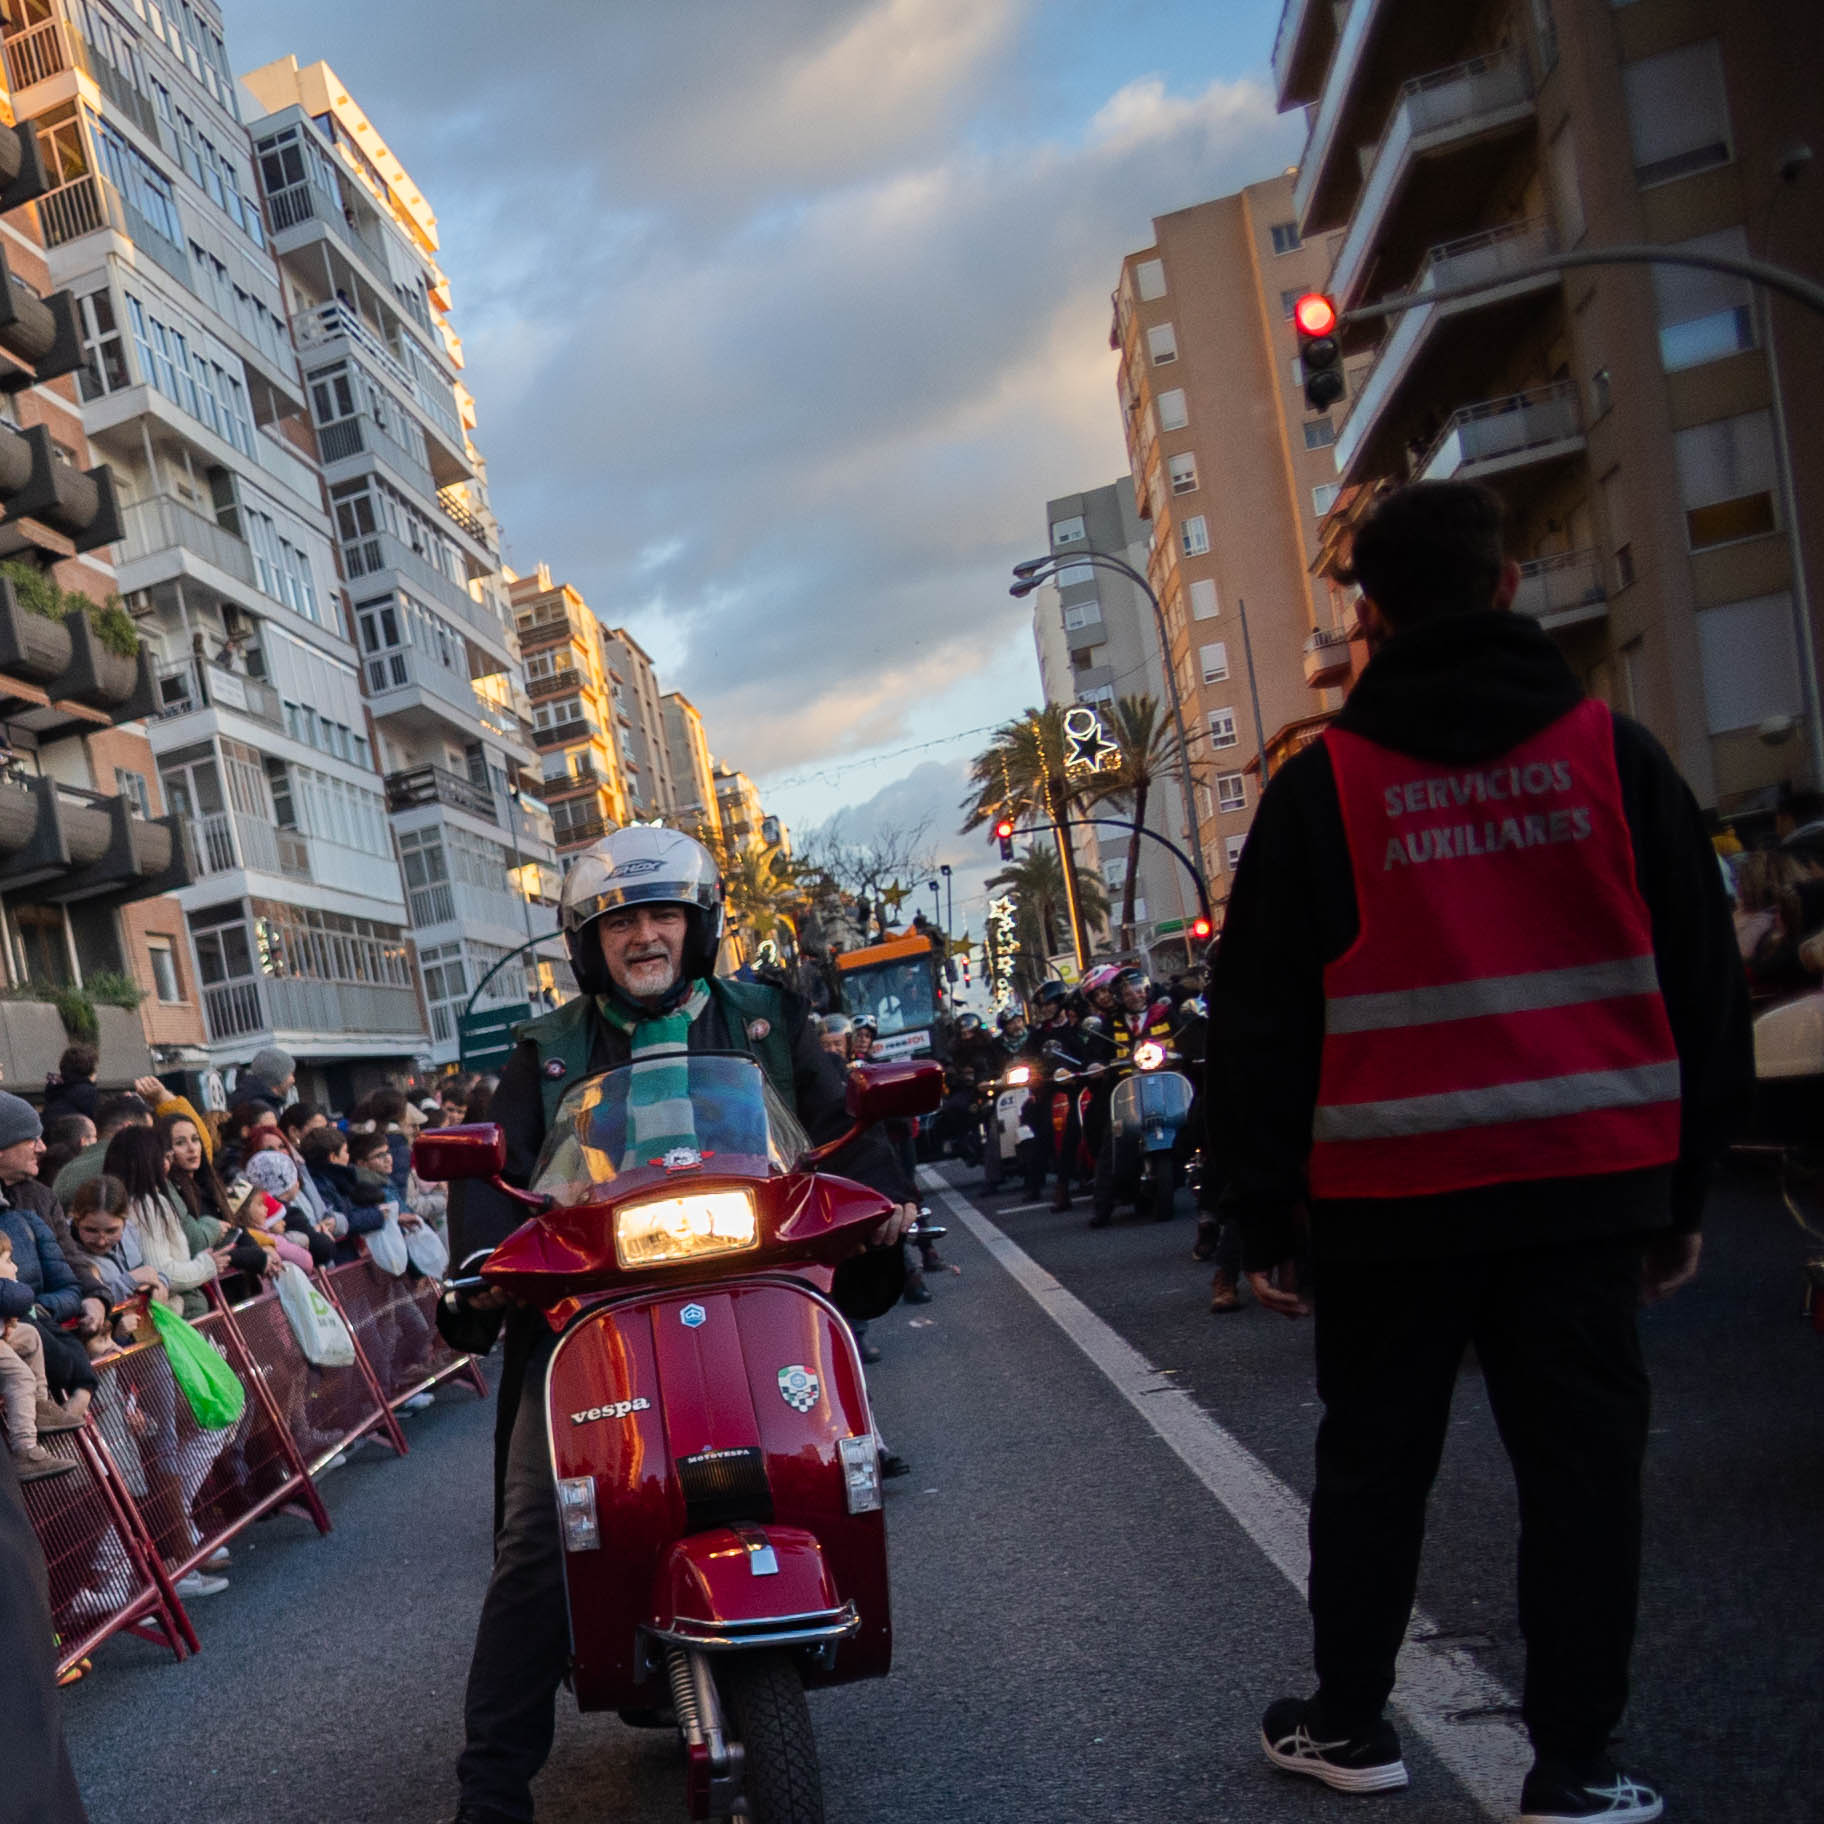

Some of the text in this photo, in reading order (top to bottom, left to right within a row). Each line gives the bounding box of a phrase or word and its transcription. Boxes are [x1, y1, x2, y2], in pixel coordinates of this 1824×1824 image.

[1384, 760, 1573, 817] SERVICIOS
[1384, 806, 1592, 871] AUXILIARES
[571, 1397, 650, 1425] vespa
[687, 1449, 751, 1464] MOTOVESPA
